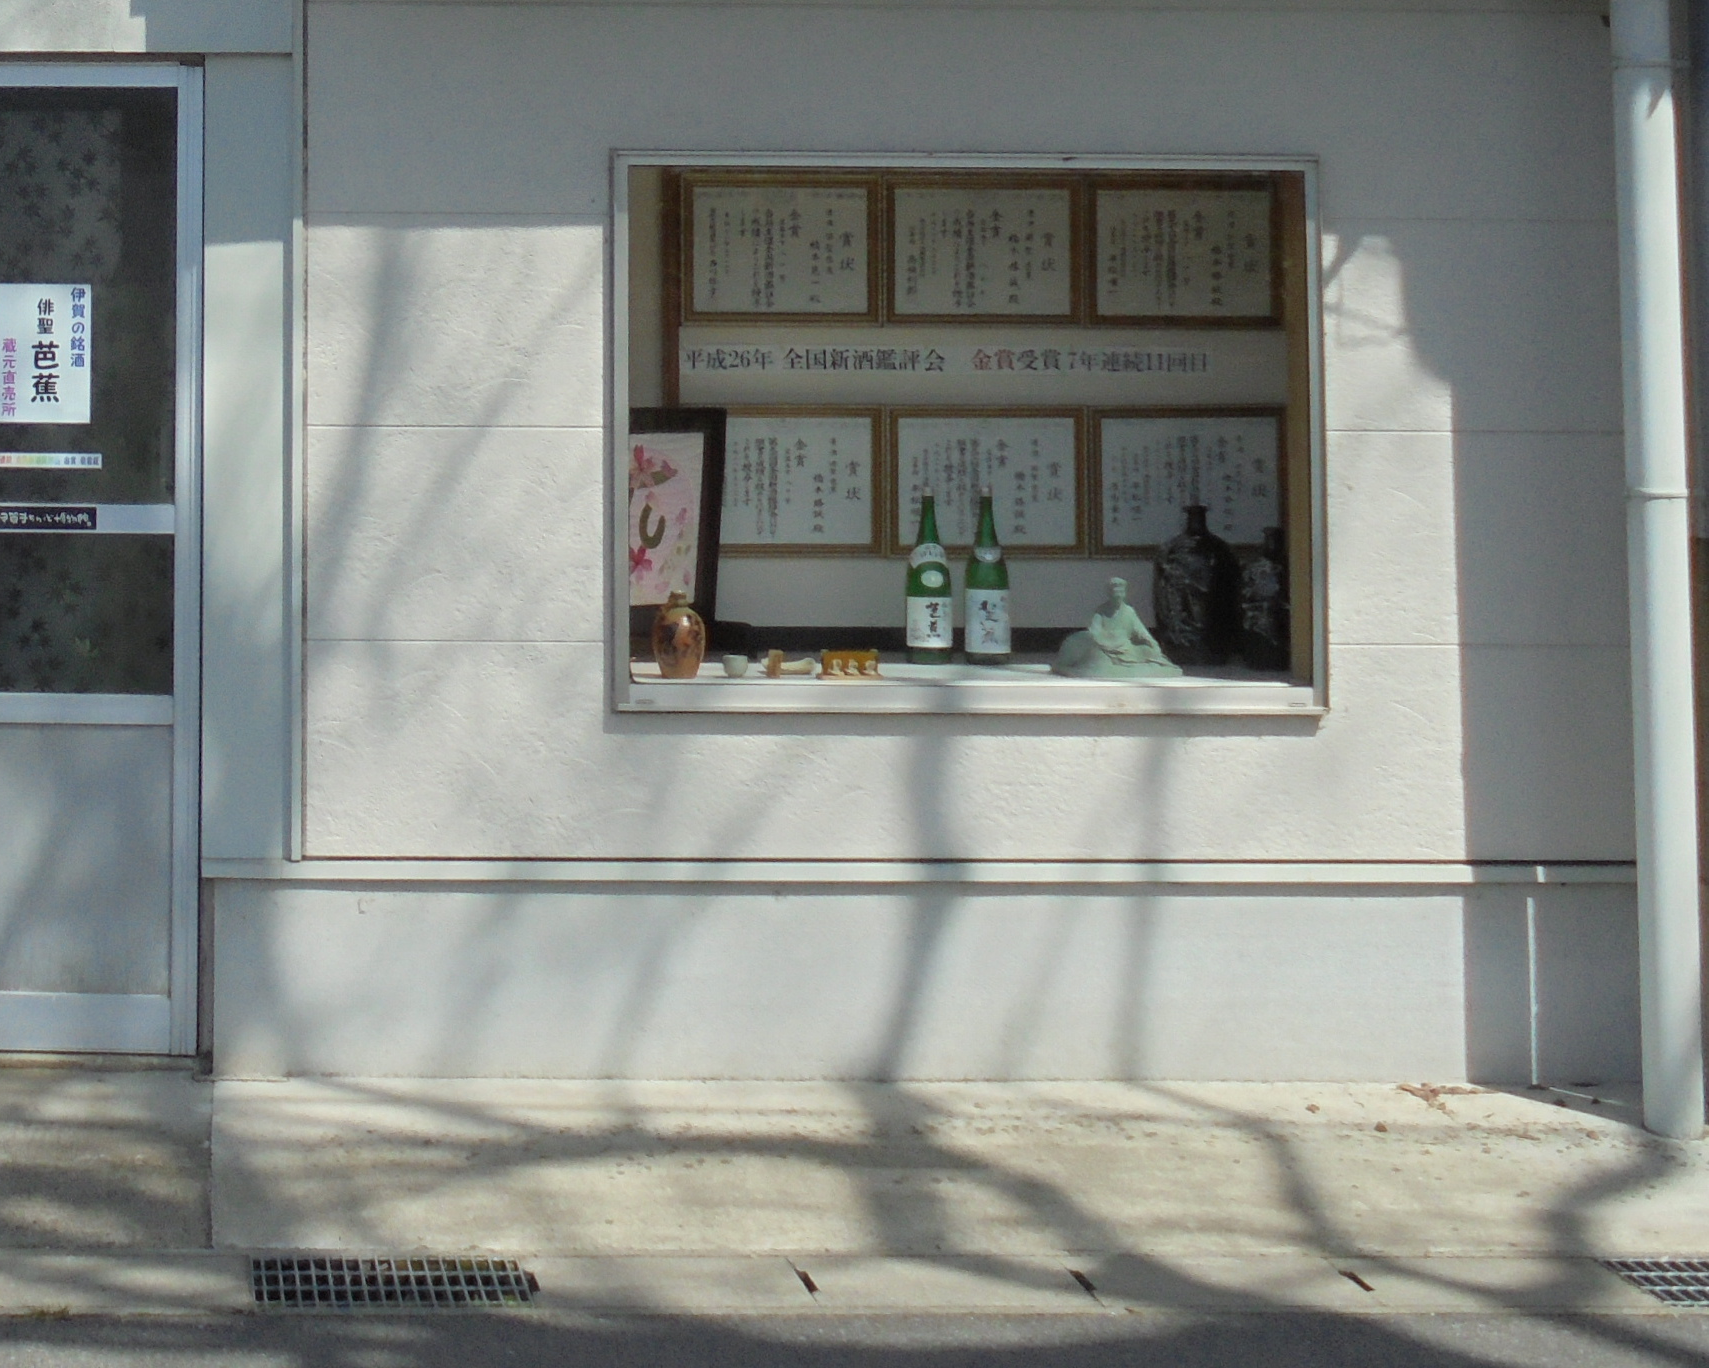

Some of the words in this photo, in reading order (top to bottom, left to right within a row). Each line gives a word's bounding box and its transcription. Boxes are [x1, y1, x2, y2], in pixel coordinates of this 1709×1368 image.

[31, 298, 60, 403] 俳聖芭蕉
[70, 287, 86, 368] 伊賀の銘酒
[684, 348, 773, 371] 平成26年
[783, 347, 946, 373] 全国新酒鑑評会
[1, 337, 17, 417] 蔵元直売所
